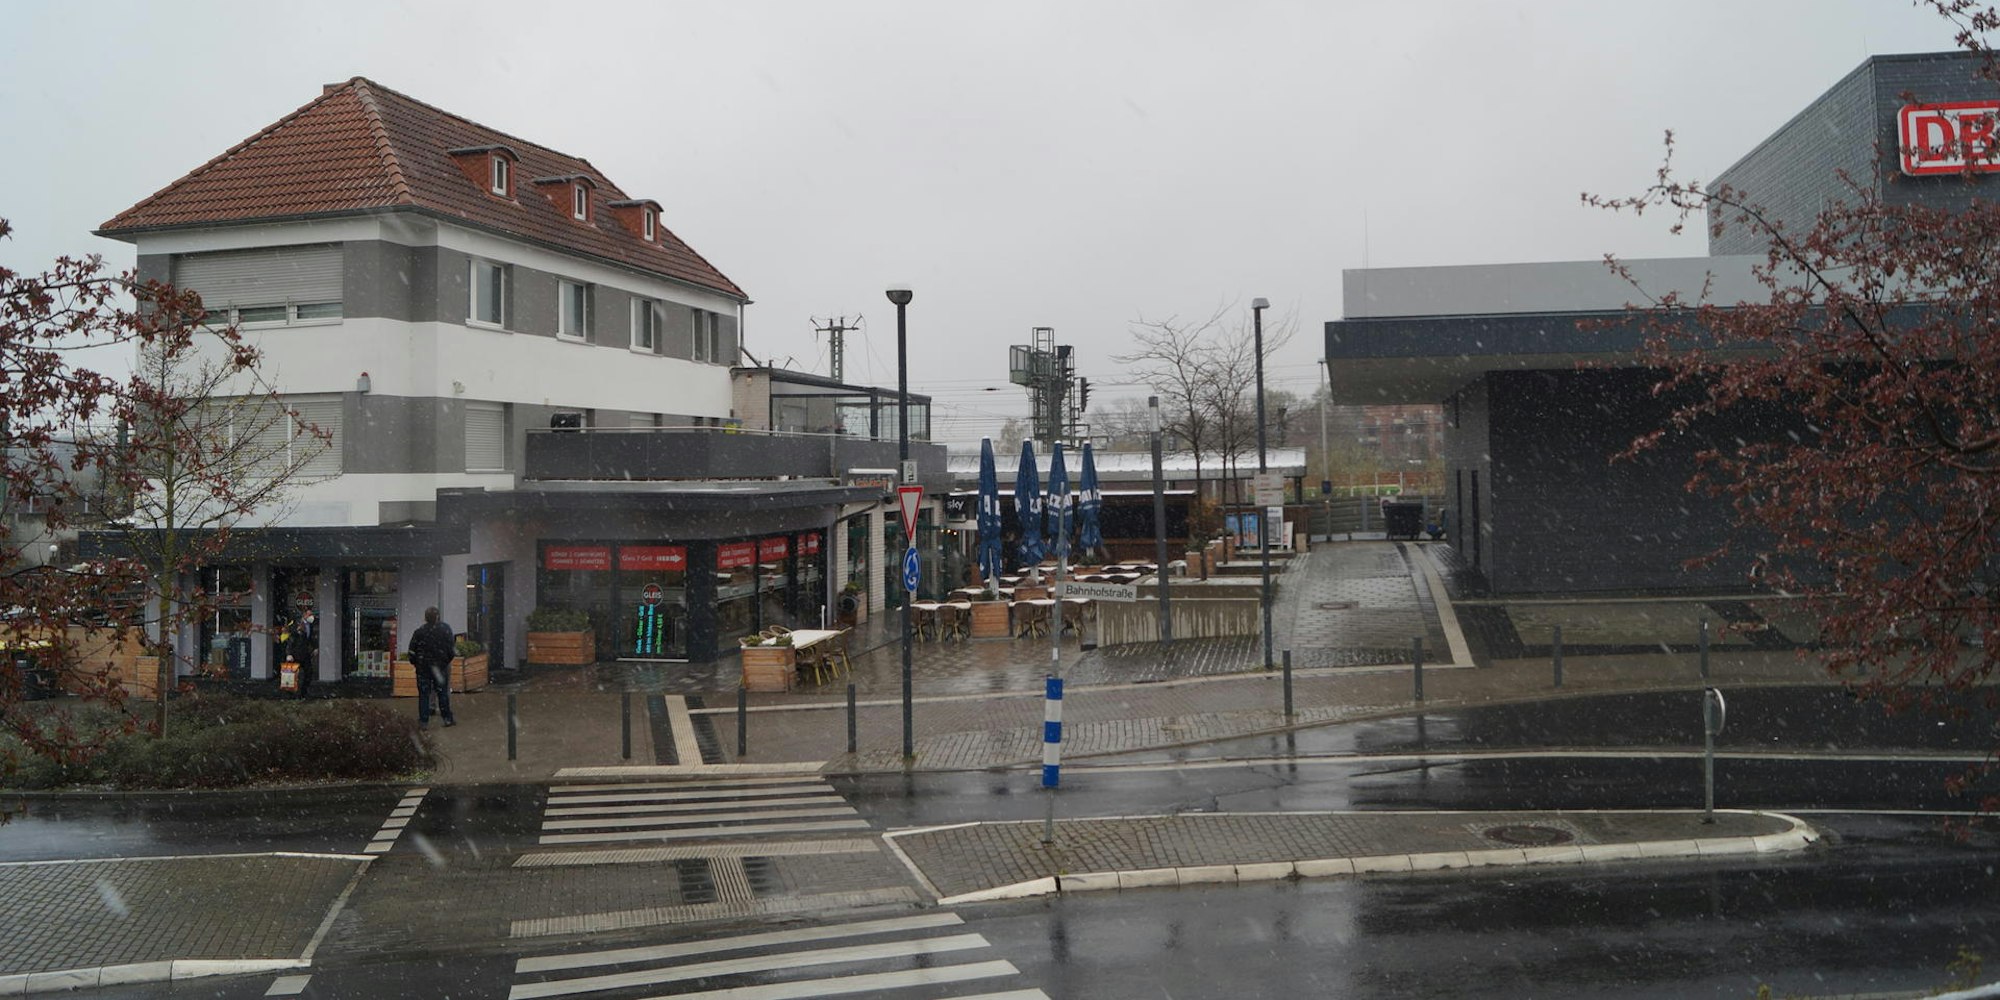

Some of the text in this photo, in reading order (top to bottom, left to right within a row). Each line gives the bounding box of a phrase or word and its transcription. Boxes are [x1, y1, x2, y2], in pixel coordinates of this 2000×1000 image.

[1915, 113, 1998, 162] DB
[946, 499, 965, 511] sky
[643, 591, 662, 599] GLEIS
[1065, 584, 1134, 599] Bahnhofstraße
[296, 598, 314, 606] GLEIS
